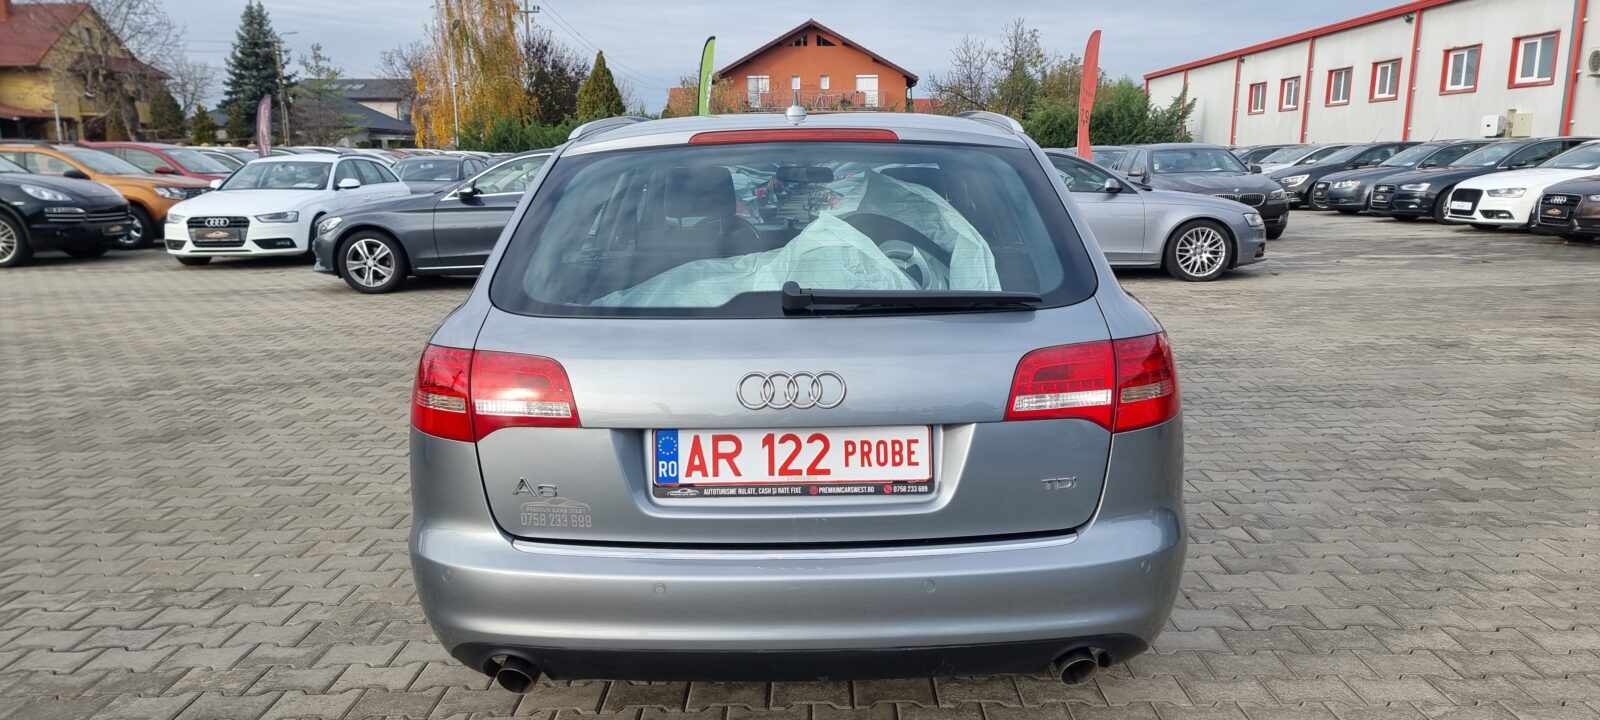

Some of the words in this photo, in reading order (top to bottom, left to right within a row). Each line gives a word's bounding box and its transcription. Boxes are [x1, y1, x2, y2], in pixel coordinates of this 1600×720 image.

[659, 461, 677, 477] RO
[685, 434, 742, 477] AR
[762, 433, 831, 477] 122
[844, 439, 919, 468] PROBE
[512, 477, 557, 497] A6
[521, 513, 546, 526] 0758
[549, 513, 568, 527] 233
